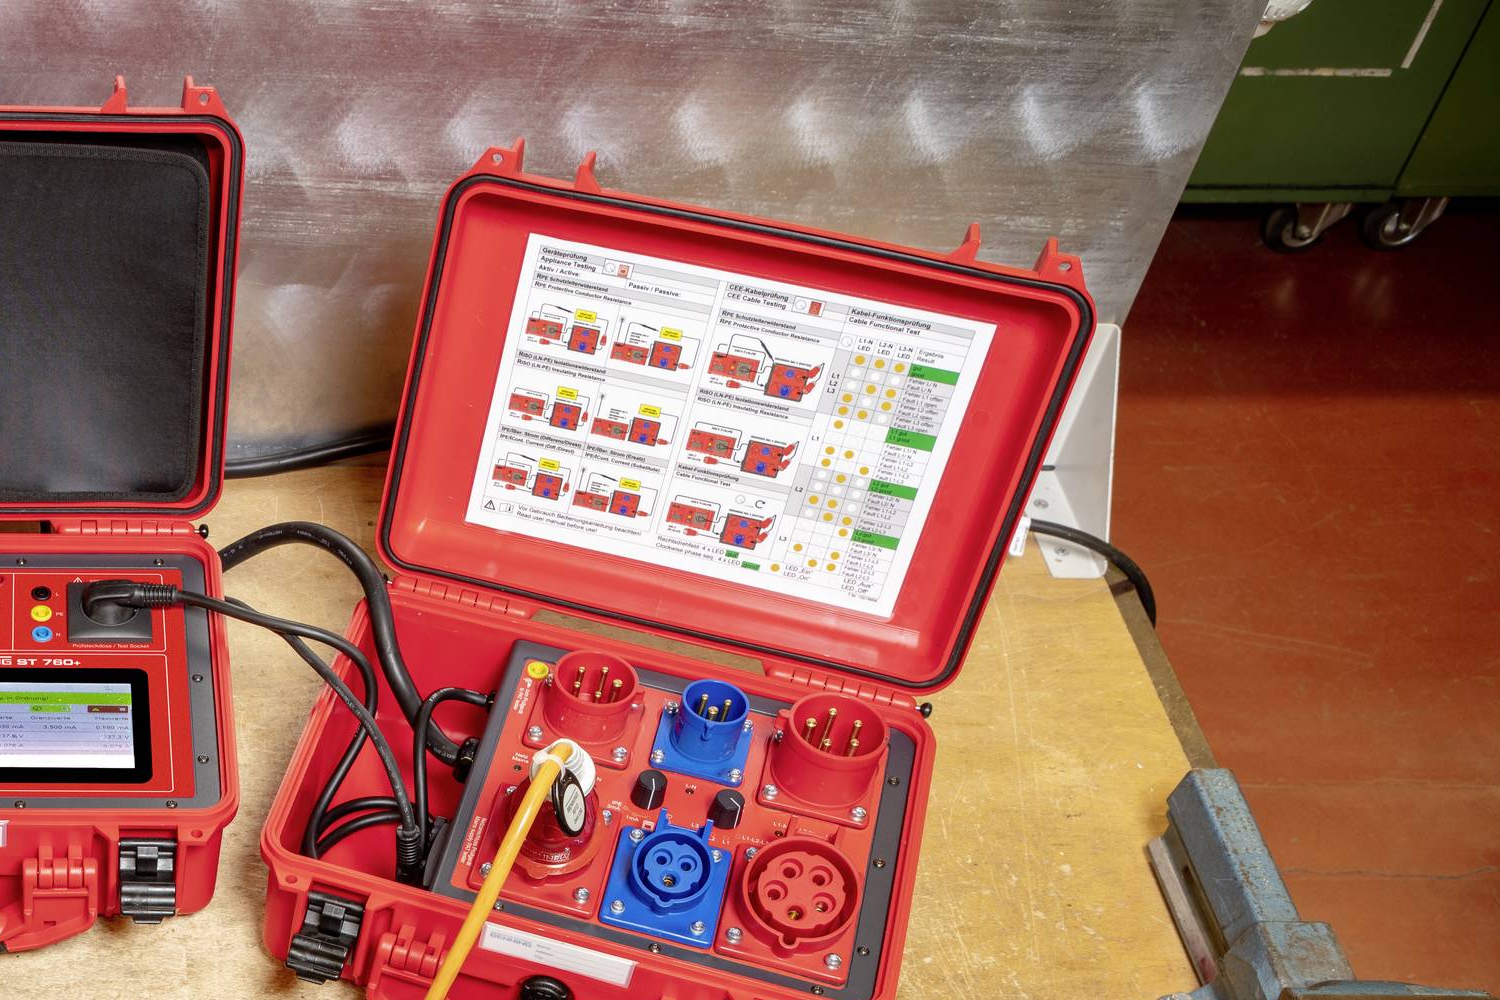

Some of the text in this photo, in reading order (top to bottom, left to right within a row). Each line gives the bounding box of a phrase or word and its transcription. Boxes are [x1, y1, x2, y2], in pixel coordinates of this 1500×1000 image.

[540, 255, 596, 272] Appliance Testing
[542, 247, 587, 262] Geräteprüfung
[726, 292, 787, 310] CEE Cable Testing
[729, 284, 789, 302] CEE-Kabelprüfung
[848, 316, 920, 335] Cable Functional Test
[851, 308, 931, 330] Kabel-Funktionsprüfung
[16, 658, 37, 666] ST
[42, 658, 81, 666] 760+
